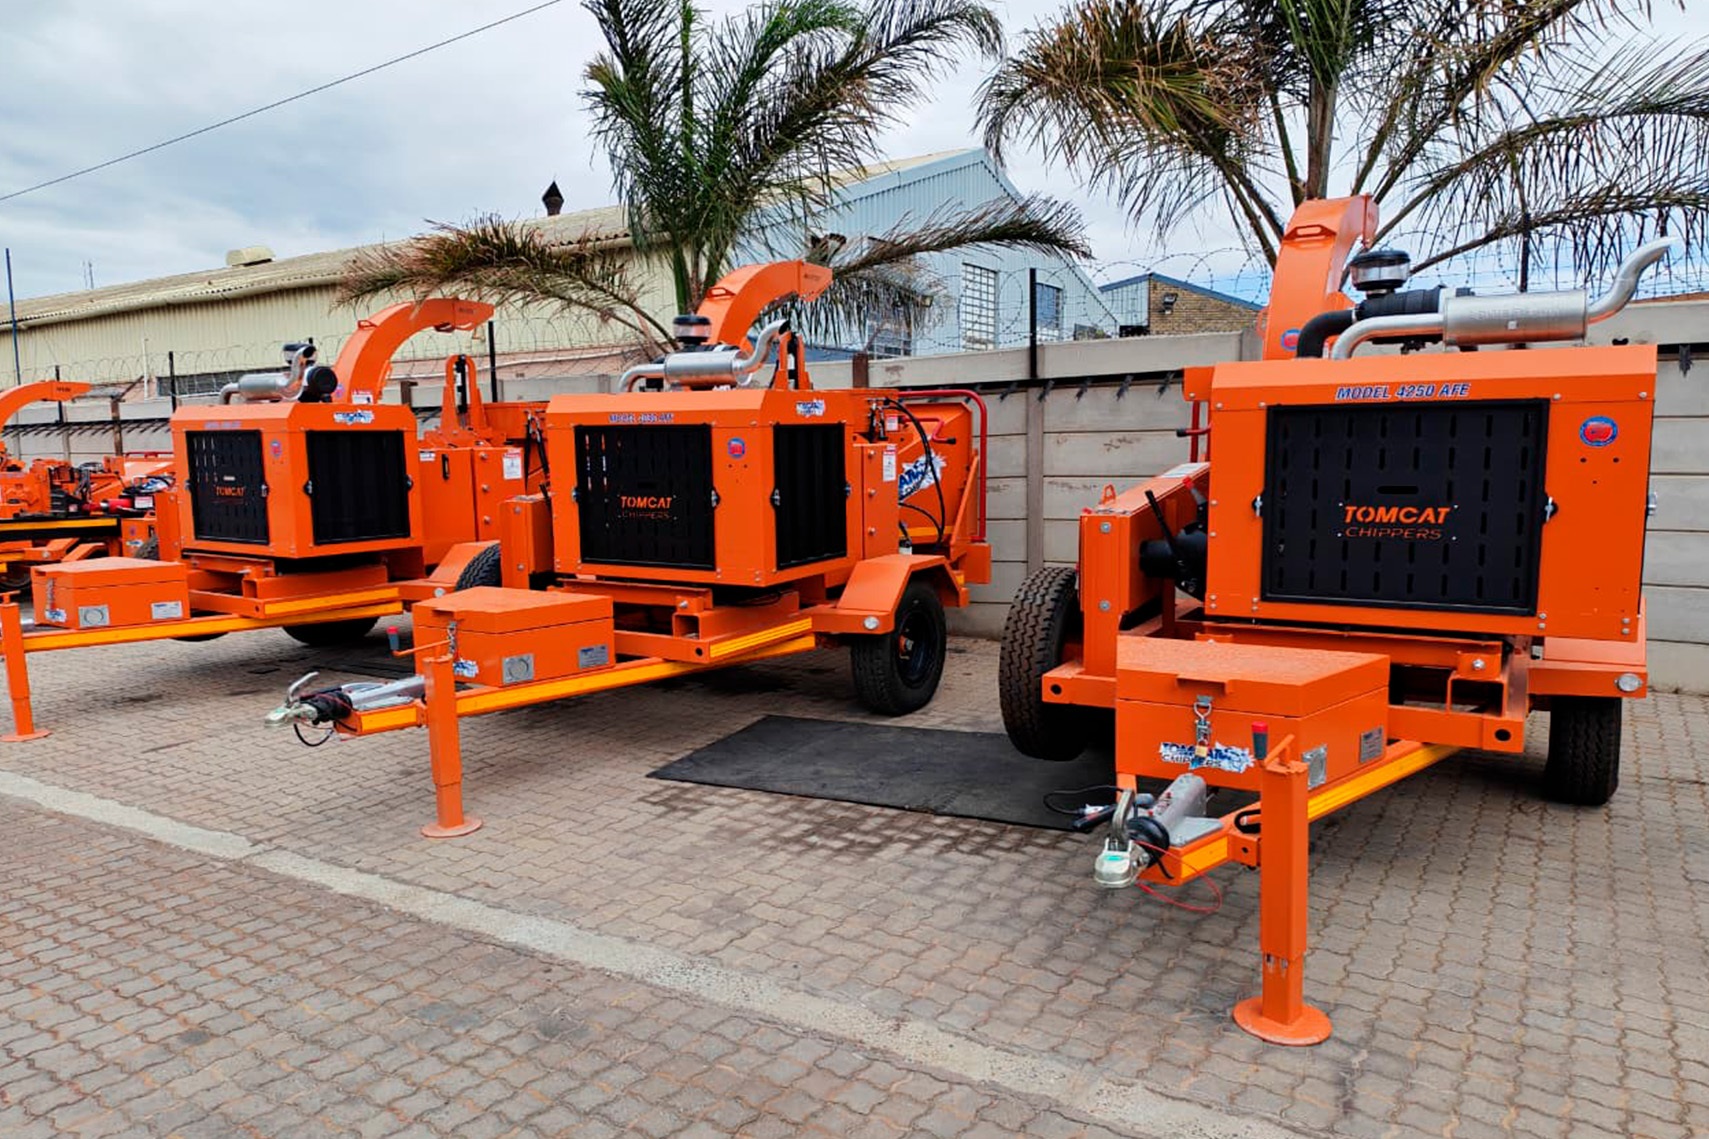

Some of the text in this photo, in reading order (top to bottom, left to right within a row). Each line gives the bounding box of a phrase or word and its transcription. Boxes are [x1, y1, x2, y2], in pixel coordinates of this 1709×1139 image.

[1336, 383, 1469, 400] MODEL 4250 AFE
[620, 495, 672, 509] TOMCAT
[1345, 505, 1450, 524] TOMCAT
[1345, 526, 1442, 540] CHIPPERS
